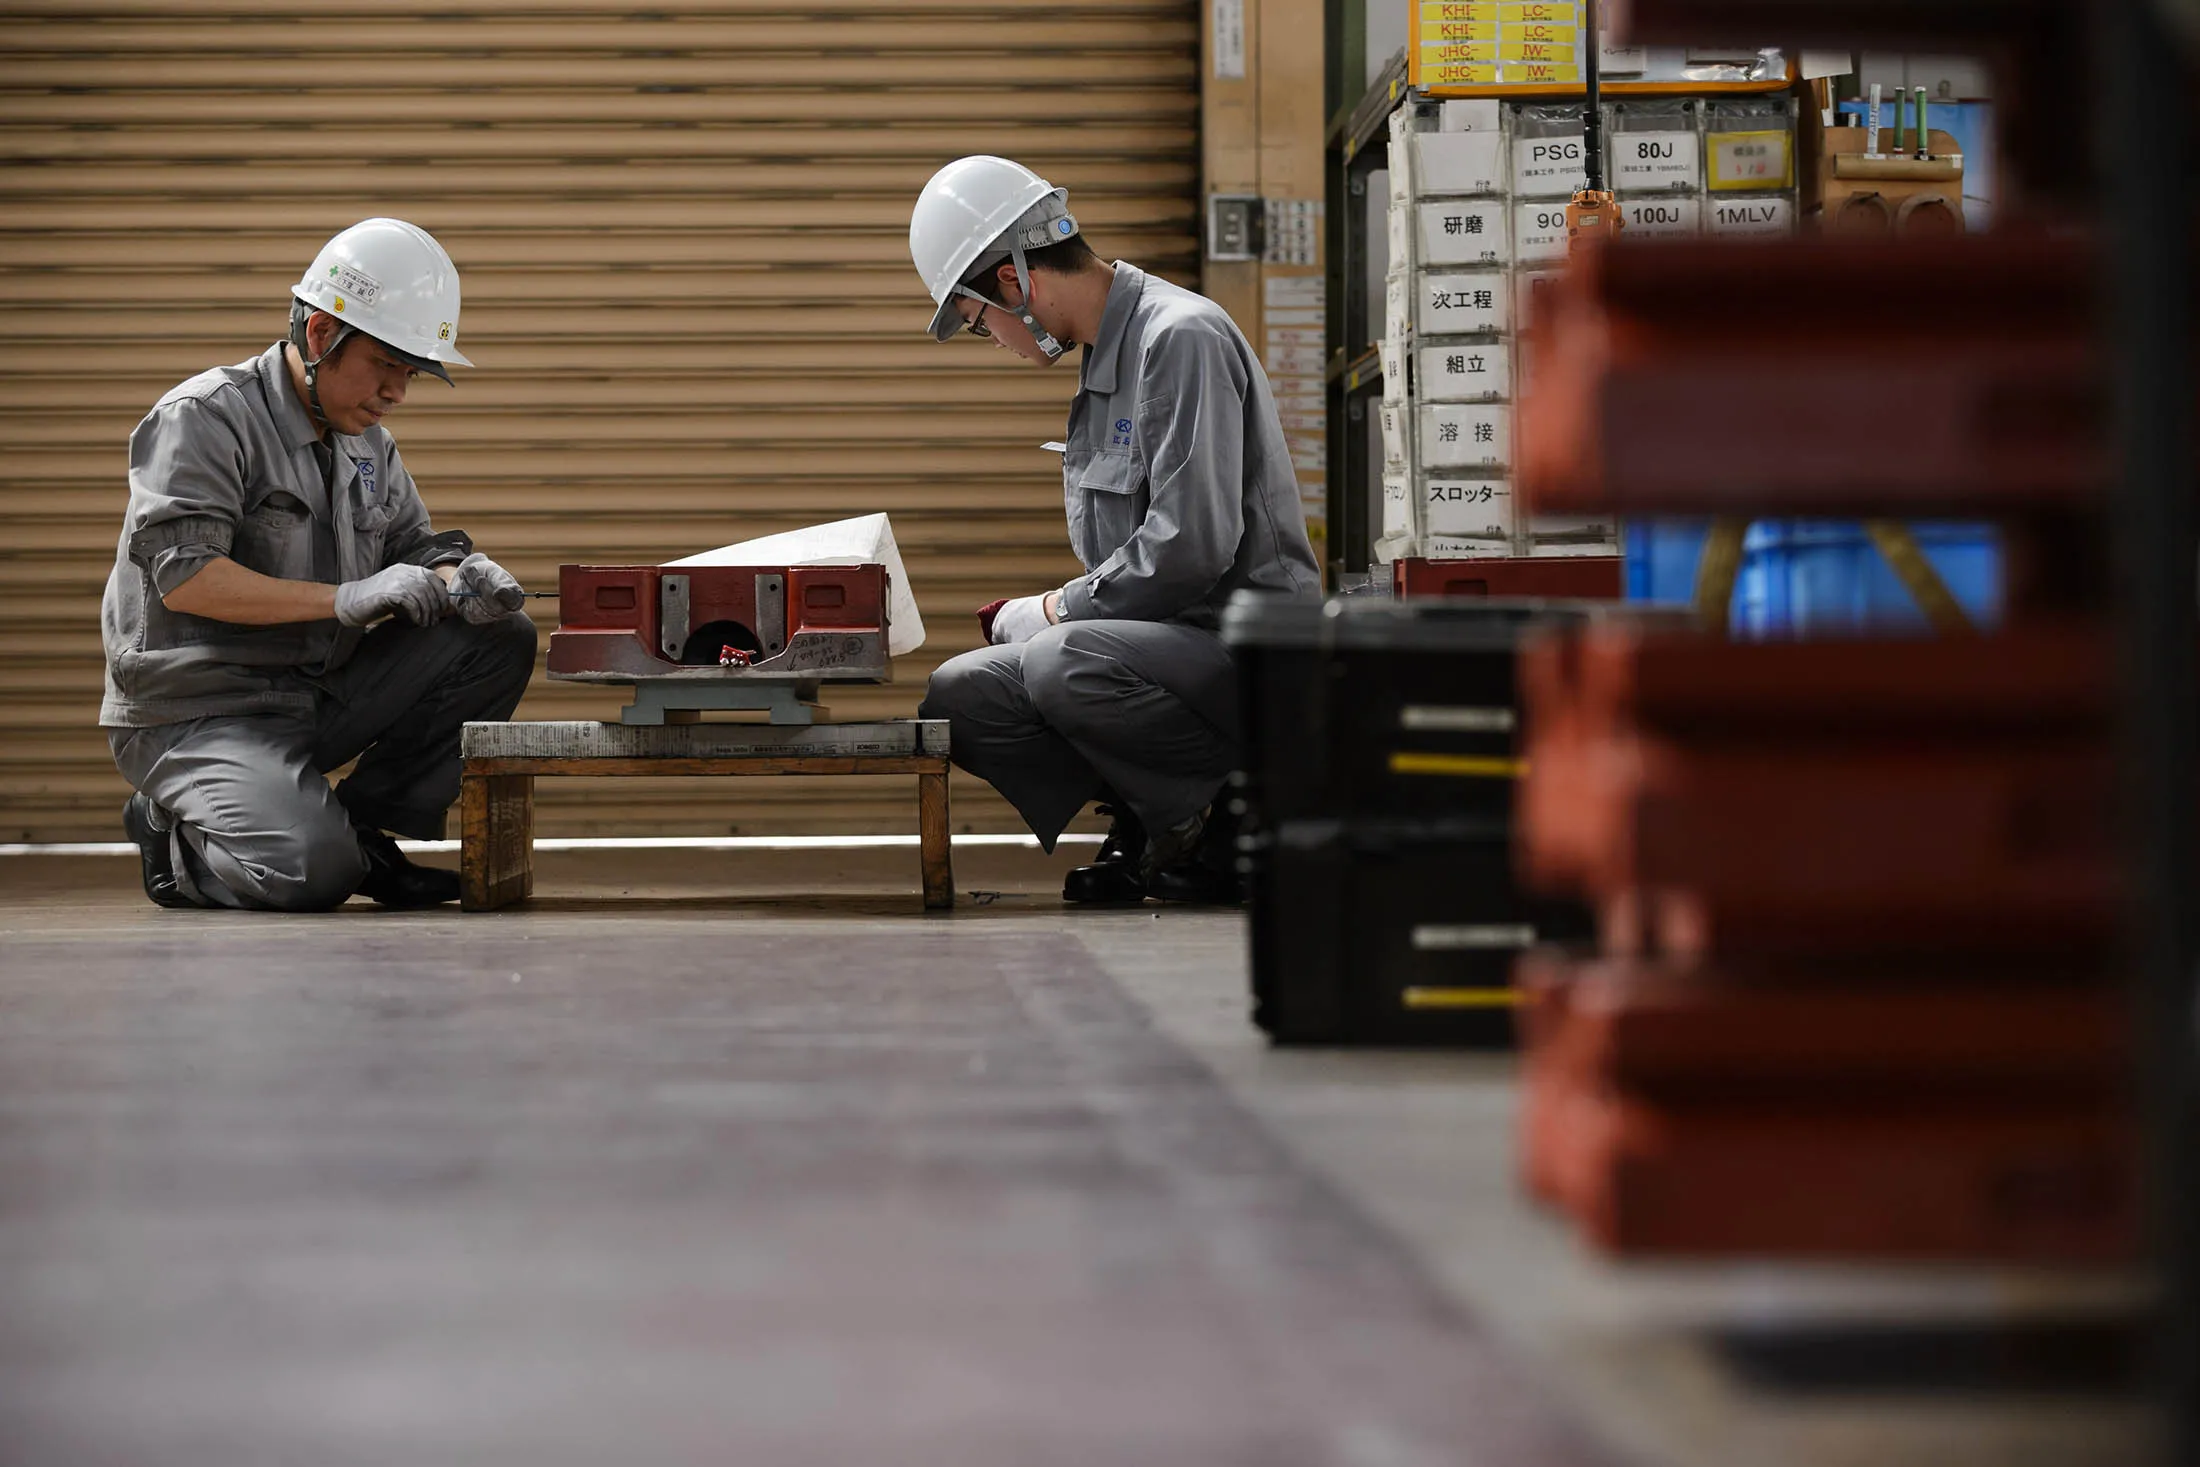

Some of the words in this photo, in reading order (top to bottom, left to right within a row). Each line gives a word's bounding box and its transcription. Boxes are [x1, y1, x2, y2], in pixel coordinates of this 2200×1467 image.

[1442, 4, 1479, 16] KHI-
[1522, 5, 1552, 17] LC-
[1440, 23, 1477, 35] KHI-
[1524, 25, 1553, 37] LC-
[1438, 44, 1480, 58] JHC-
[1523, 44, 1550, 56] IW-
[1438, 66, 1479, 79] JHC-
[1527, 66, 1555, 77] IW-
[1533, 143, 1579, 162] PSG
[1638, 142, 1673, 159] 80J
[1632, 207, 1680, 224] 100J
[1716, 206, 1776, 225] 1MLV
[1443, 214, 1484, 235] 研磨
[1432, 289, 1493, 309] 次工程
[1446, 354, 1487, 375] 組立
[1429, 485, 1511, 503] スロッター
